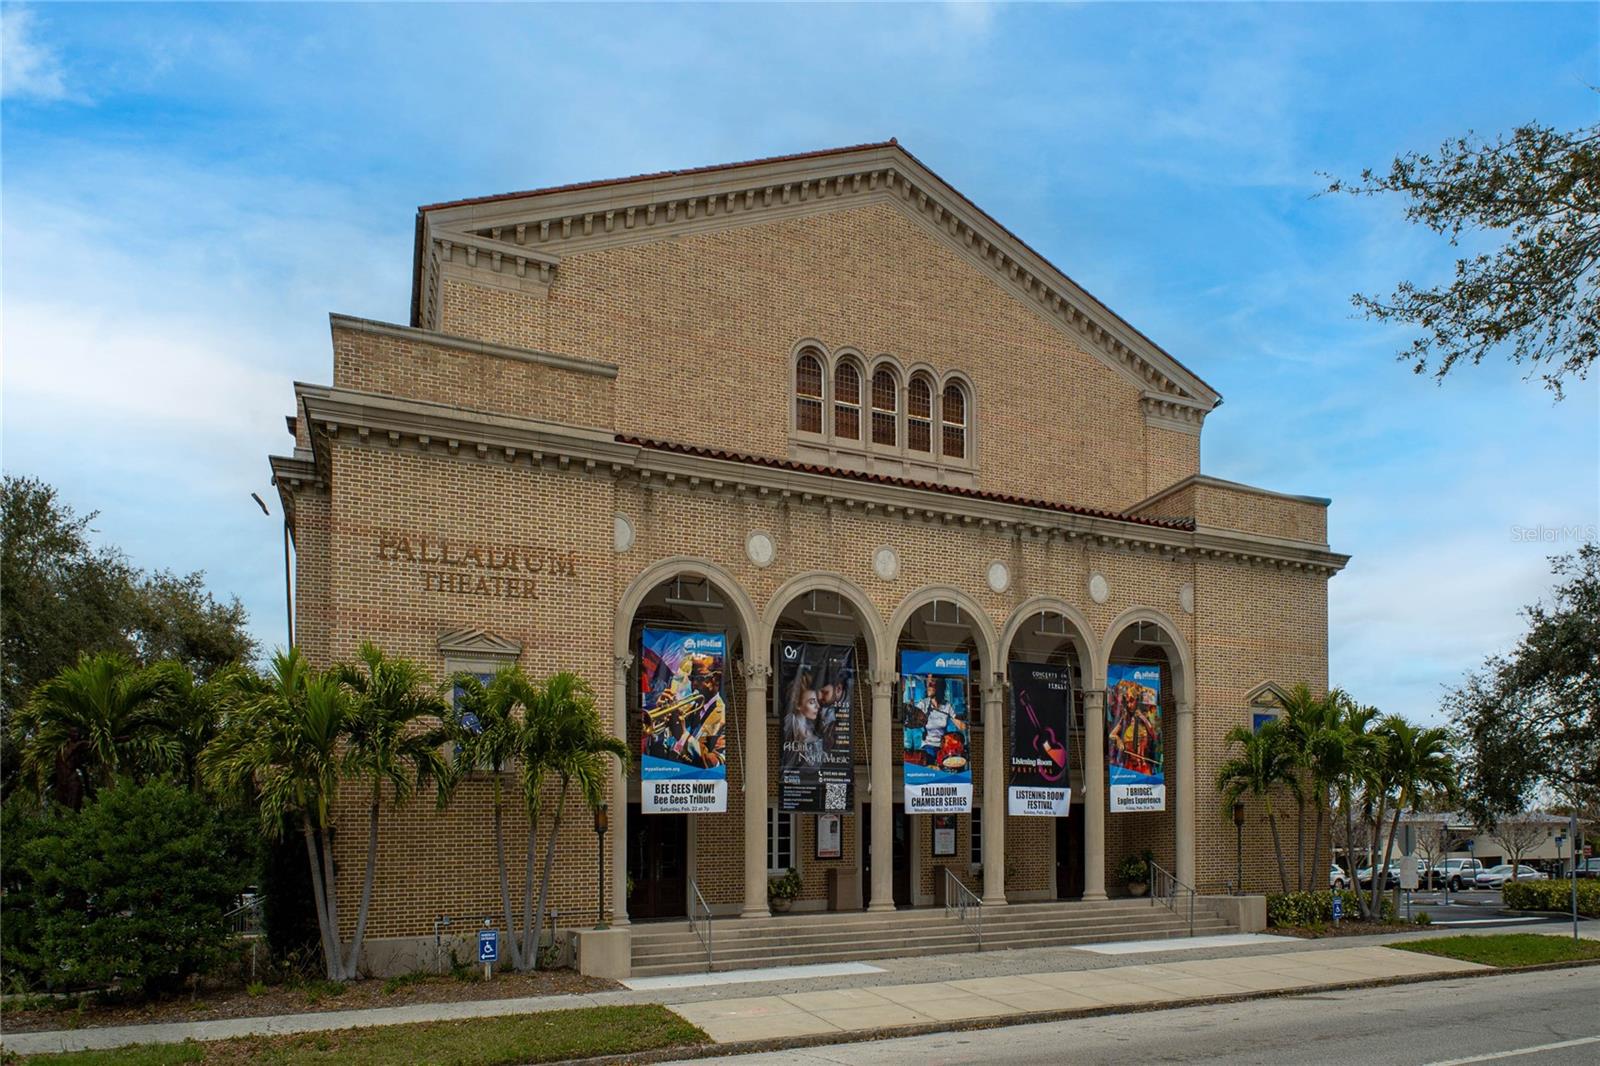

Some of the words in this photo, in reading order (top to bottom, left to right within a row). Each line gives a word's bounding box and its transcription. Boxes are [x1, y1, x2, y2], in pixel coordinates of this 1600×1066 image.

[420, 570, 540, 600] THEATER
[1012, 757, 1036, 766] Listening
[1036, 758, 1053, 766] Room
[655, 783, 670, 794] BEE
[671, 783, 691, 794] GEES
[692, 783, 715, 794] NOW!
[921, 786, 958, 797] PALLADIUM
[653, 795, 668, 805] Bee
[669, 795, 688, 805] Gees
[689, 794, 716, 804] Tribute
[1016, 790, 1046, 800] LISTENING
[1047, 791, 1065, 801] ROOM
[911, 797, 943, 807] CHAMBER
[944, 796, 968, 806] SERIES
[1027, 800, 1053, 810] FESTIVAL
